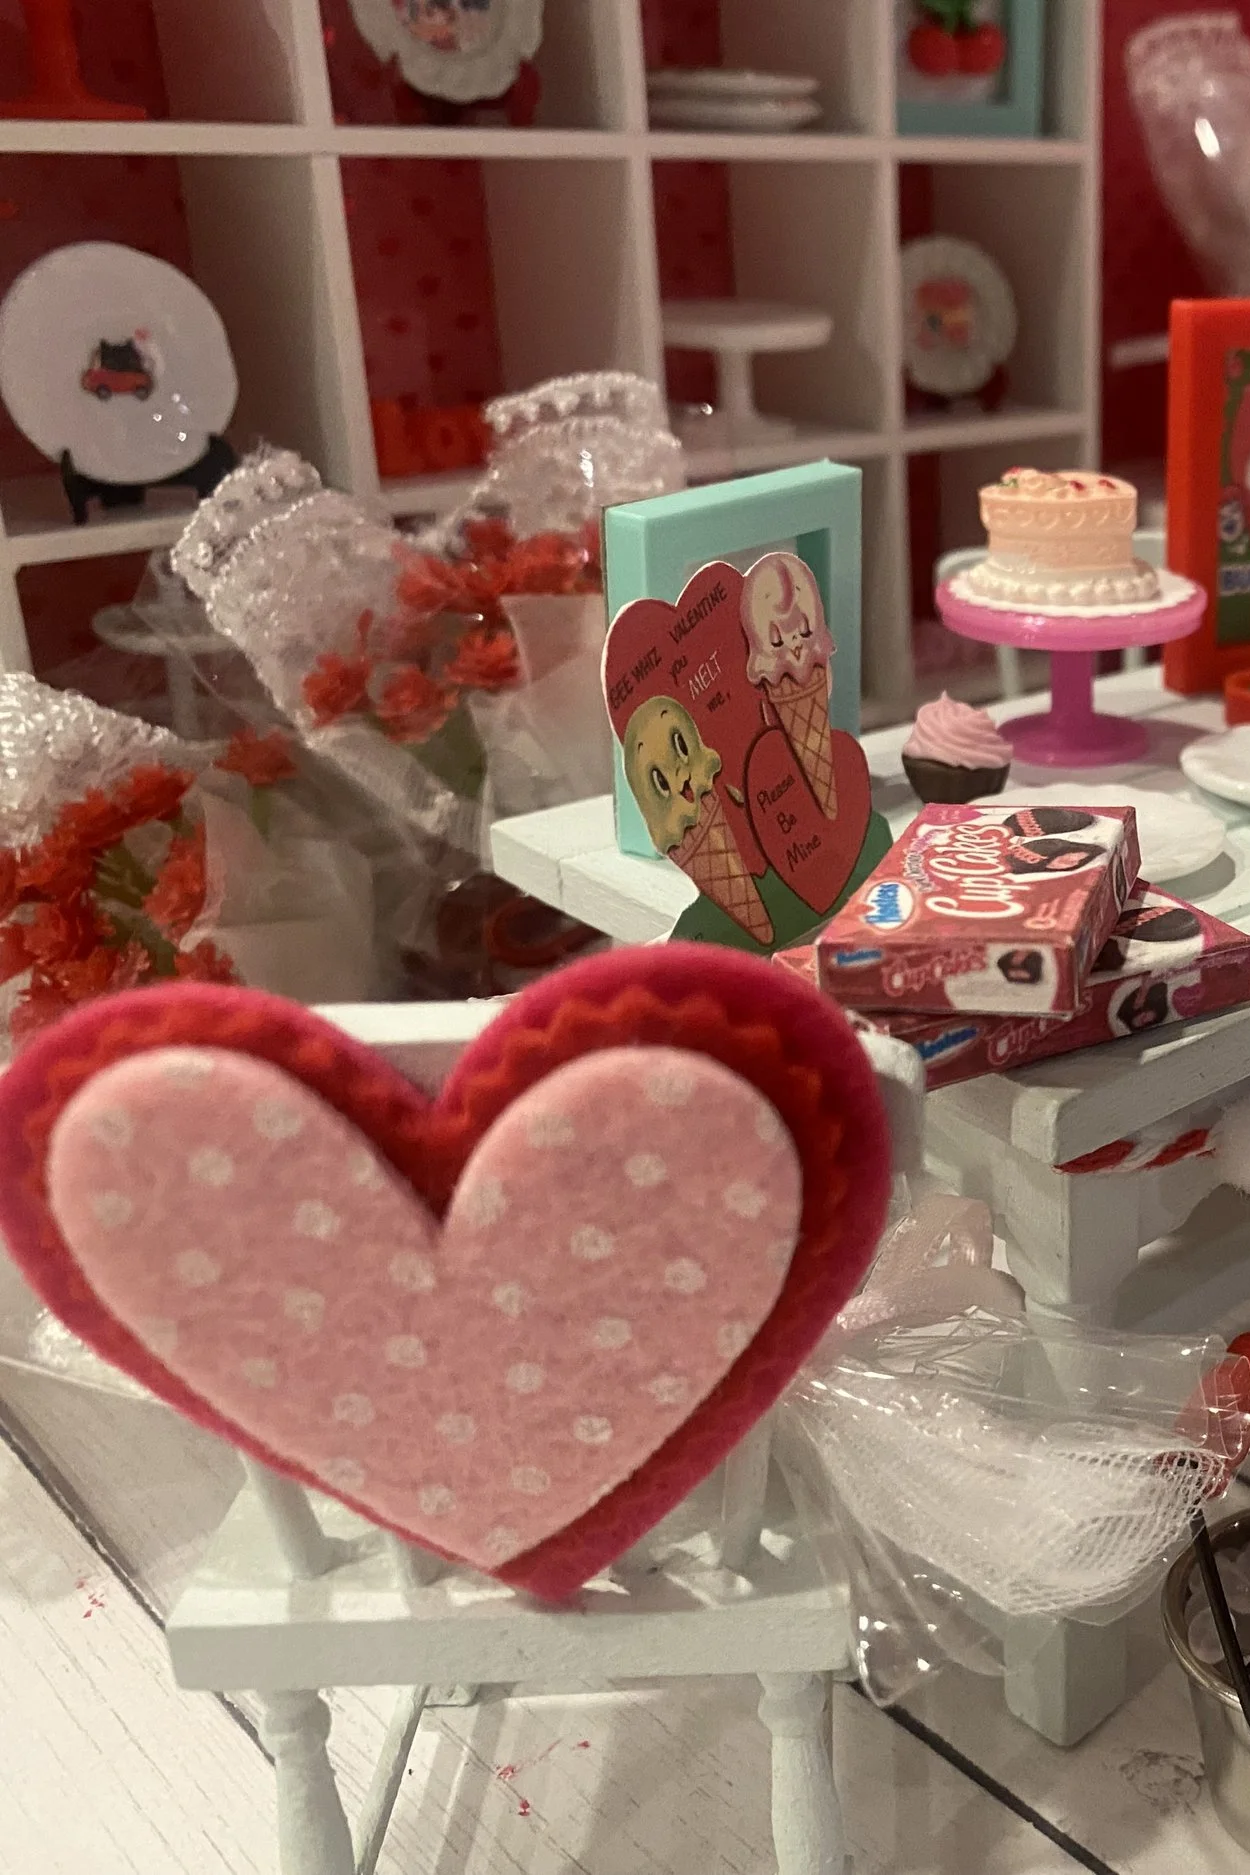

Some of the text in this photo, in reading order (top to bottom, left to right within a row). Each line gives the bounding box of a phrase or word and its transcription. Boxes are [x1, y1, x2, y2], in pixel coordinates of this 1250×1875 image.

[669, 581, 728, 645] VALENTINE
[688, 650, 723, 701] MELT
[756, 773, 796, 815] Please
[777, 812, 797, 835] Be
[785, 832, 822, 873] Mine
